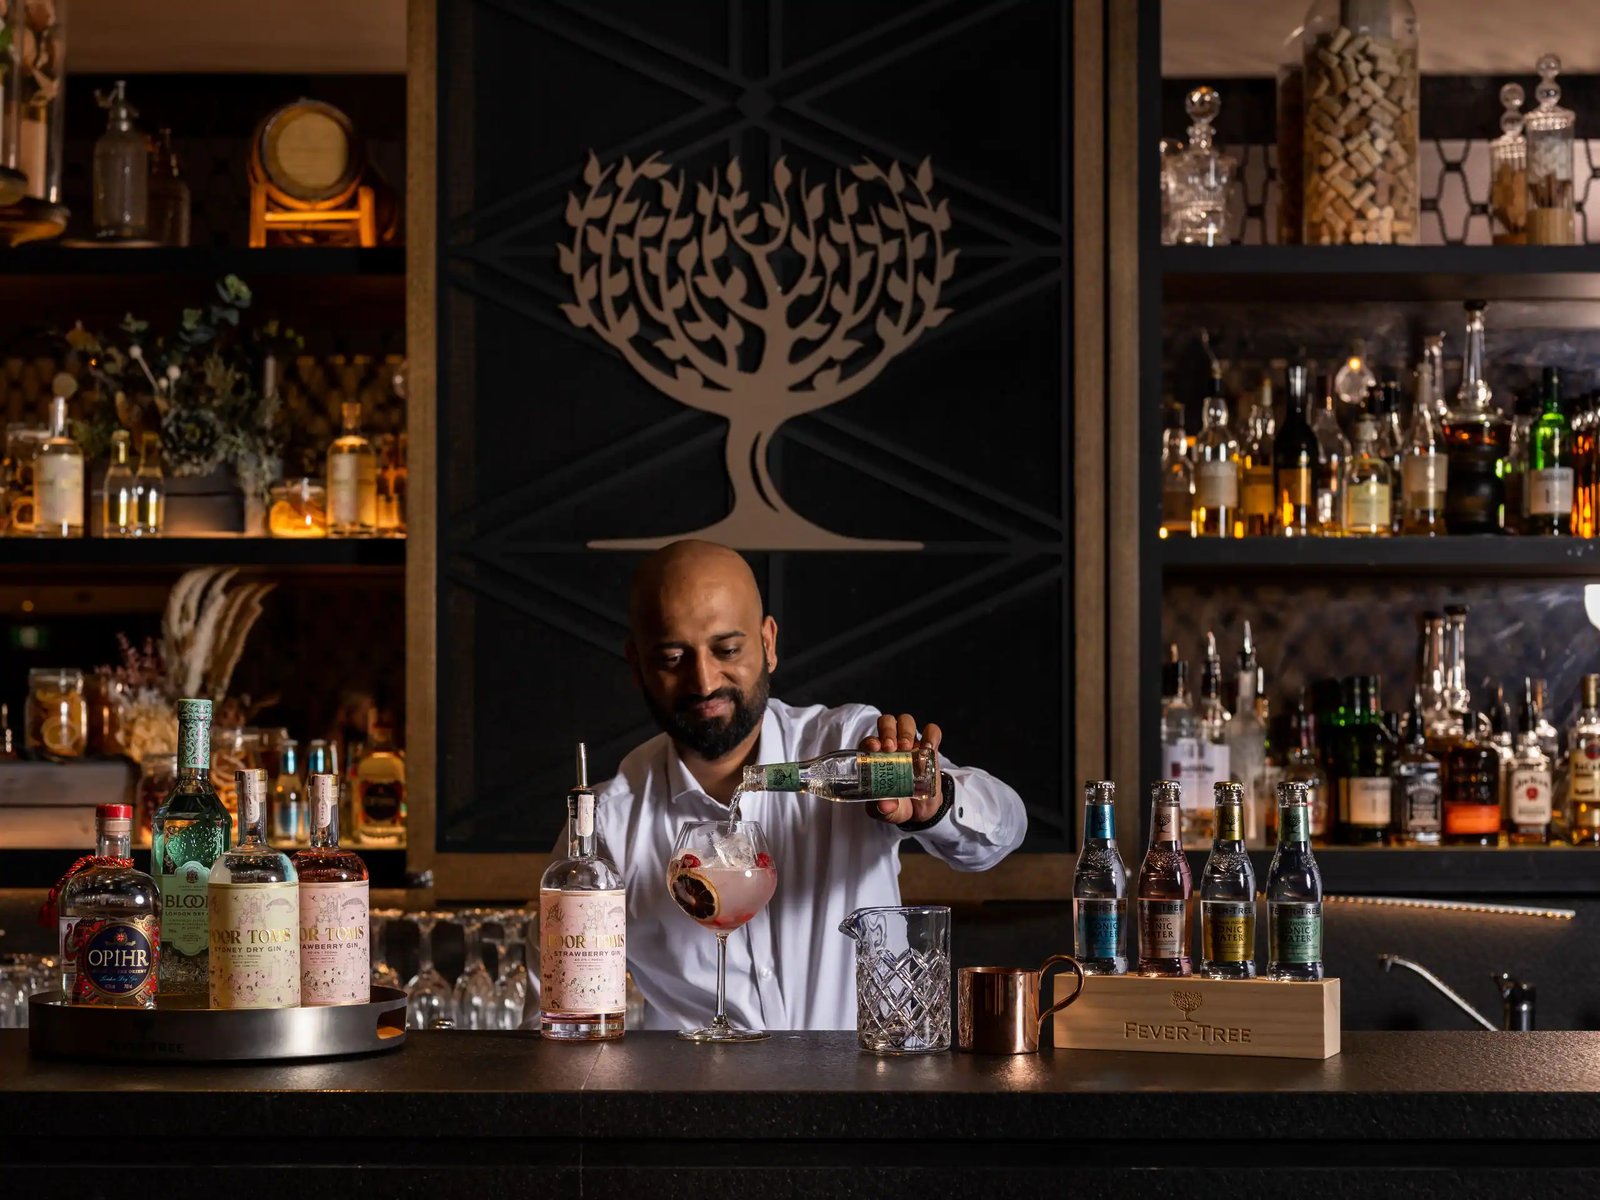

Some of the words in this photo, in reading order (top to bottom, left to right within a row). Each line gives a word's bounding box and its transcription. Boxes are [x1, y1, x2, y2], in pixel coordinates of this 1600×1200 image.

[886, 761, 894, 791] WATER
[325, 926, 364, 941] TOMS
[88, 949, 149, 967] OPIHR
[1124, 1022, 1251, 1043] FEVER-TREE
